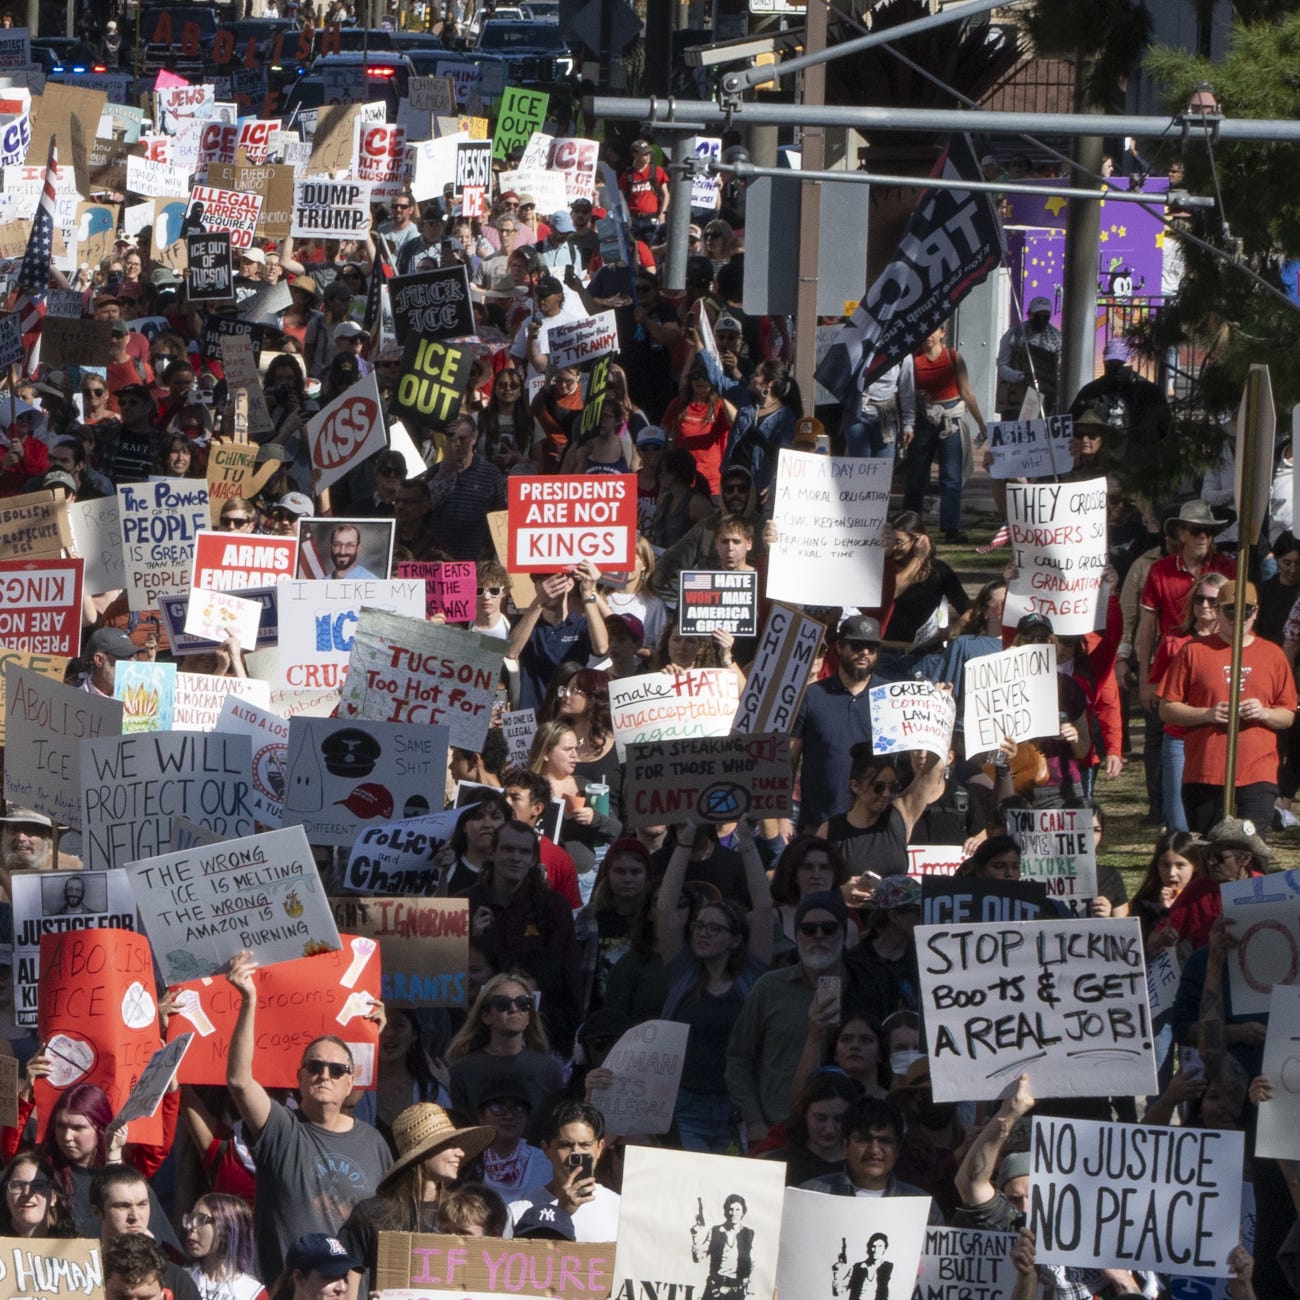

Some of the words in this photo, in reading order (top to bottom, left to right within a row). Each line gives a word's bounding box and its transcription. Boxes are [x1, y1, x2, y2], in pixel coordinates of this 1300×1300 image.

[457, 149, 490, 186] RESIST
[193, 187, 259, 209] ILLEGAL
[304, 183, 360, 206] DUMP
[463, 187, 485, 216] ICE
[202, 215, 244, 230] REQUIRE
[247, 222, 254, 231] A
[204, 204, 257, 221] ARRESTS
[297, 208, 364, 230] TRUMP
[191, 243, 205, 256] ICE
[210, 240, 228, 255] OUT
[203, 256, 215, 267] OF
[191, 269, 229, 286] TUCSON
[414, 339, 461, 384] ICE
[399, 375, 459, 420] OUT
[520, 481, 626, 500] PRESIDENTS
[526, 503, 568, 523] ARE
[574, 501, 619, 521] NOT
[530, 532, 615, 557] KINGS
[715, 575, 751, 588] HATE
[685, 591, 721, 604] WON'T
[687, 607, 750, 619] AMERICA
[139, 860, 193, 888] THE
[200, 845, 266, 873] WRONG
[171, 883, 201, 903] ICE
[211, 877, 229, 894] IS
[233, 861, 303, 889] MELTING
[158, 905, 206, 926] THE
[211, 895, 268, 916] WRONG
[186, 915, 249, 941] AMAZON
[259, 907, 273, 921] IS
[241, 921, 310, 948] BURNING
[926, 931, 1024, 974] STOP
[1037, 931, 1139, 967] LICKING
[1074, 972, 1144, 1003] GET
[936, 1025, 961, 1057] A
[965, 1012, 1062, 1060] REAL
[1034, 1123, 1077, 1176] NO
[1082, 1128, 1218, 1188] JUSTICE
[1031, 1182, 1081, 1251] NO
[1095, 1191, 1218, 1266] PEACE
